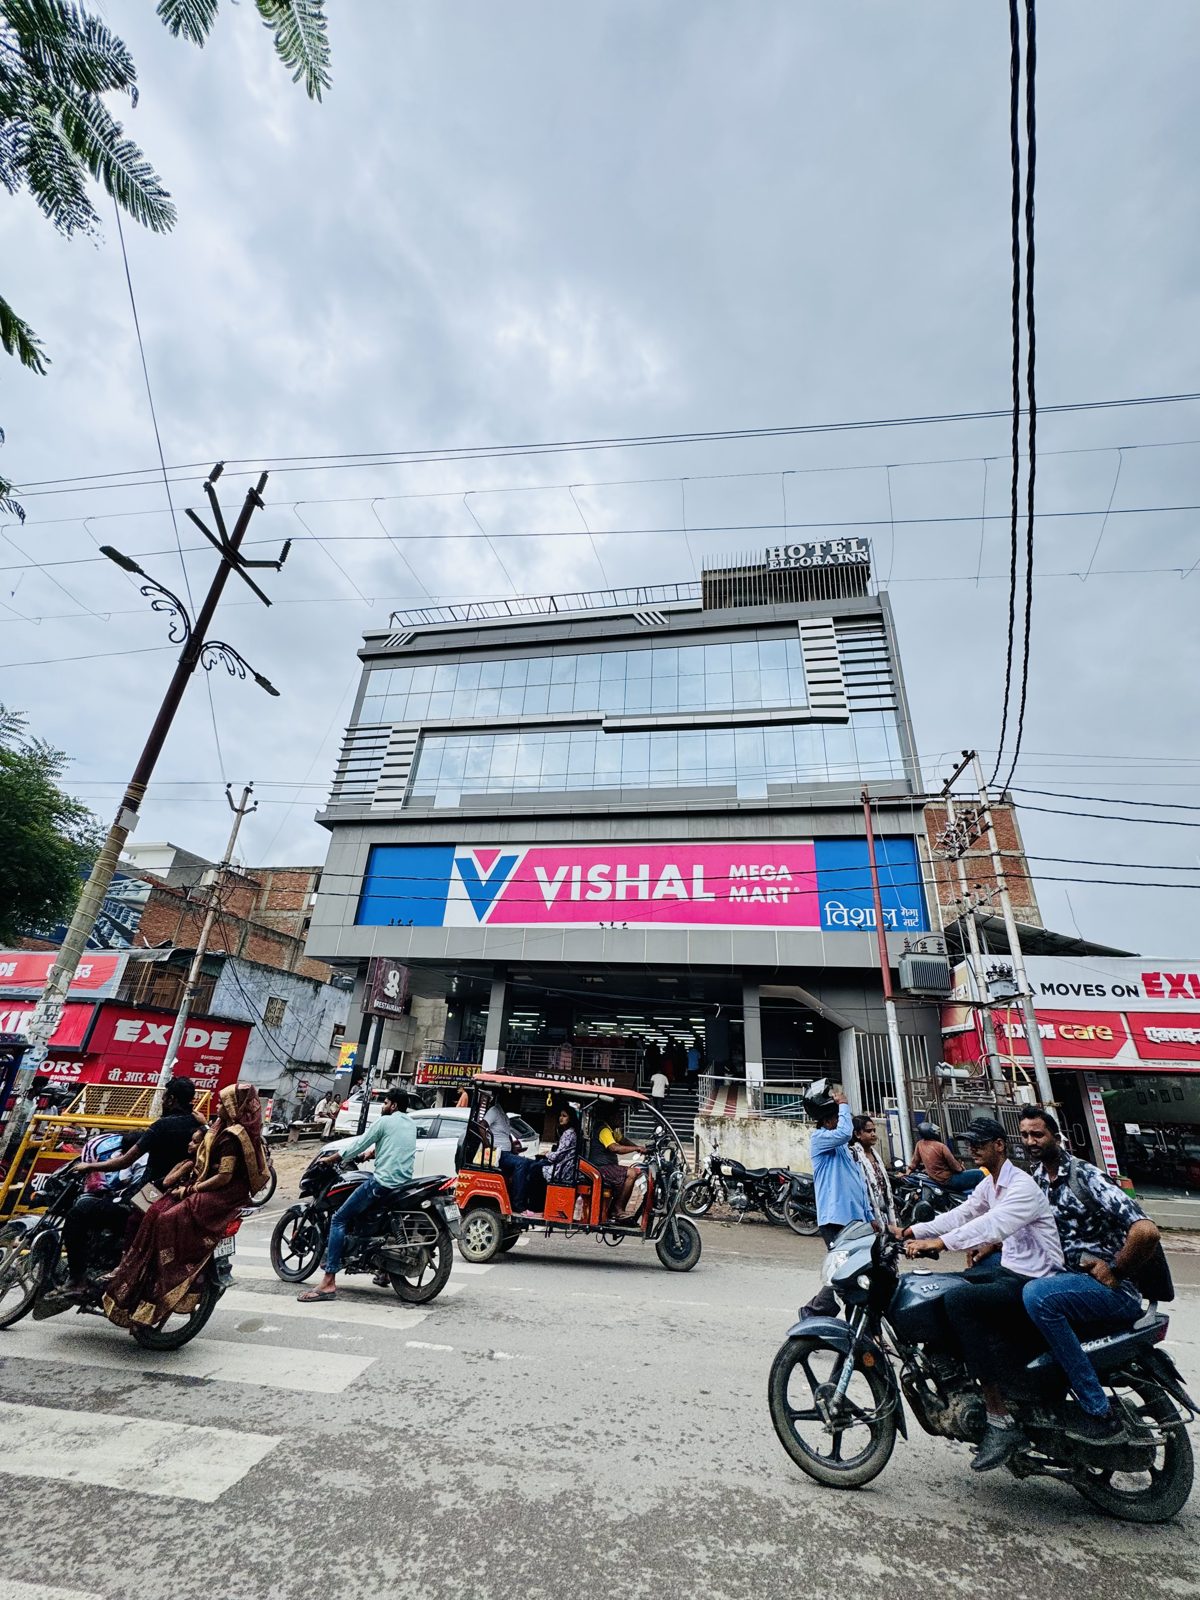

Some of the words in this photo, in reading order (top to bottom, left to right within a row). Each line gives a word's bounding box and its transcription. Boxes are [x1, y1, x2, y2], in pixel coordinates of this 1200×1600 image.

[768, 539, 866, 561] HOTEL
[768, 555, 835, 570] ELLORA
[838, 551, 869, 564] INN
[534, 864, 716, 911] VISHAL
[728, 864, 793, 882] MEGA
[823, 900, 899, 928] विशाल
[1040, 982, 1107, 997] MOVES
[1111, 984, 1140, 998] ON
[1058, 1024, 1114, 1041] cafe
[427, 1064, 464, 1076] PARKING
[920, 1282, 940, 1294] TVS
